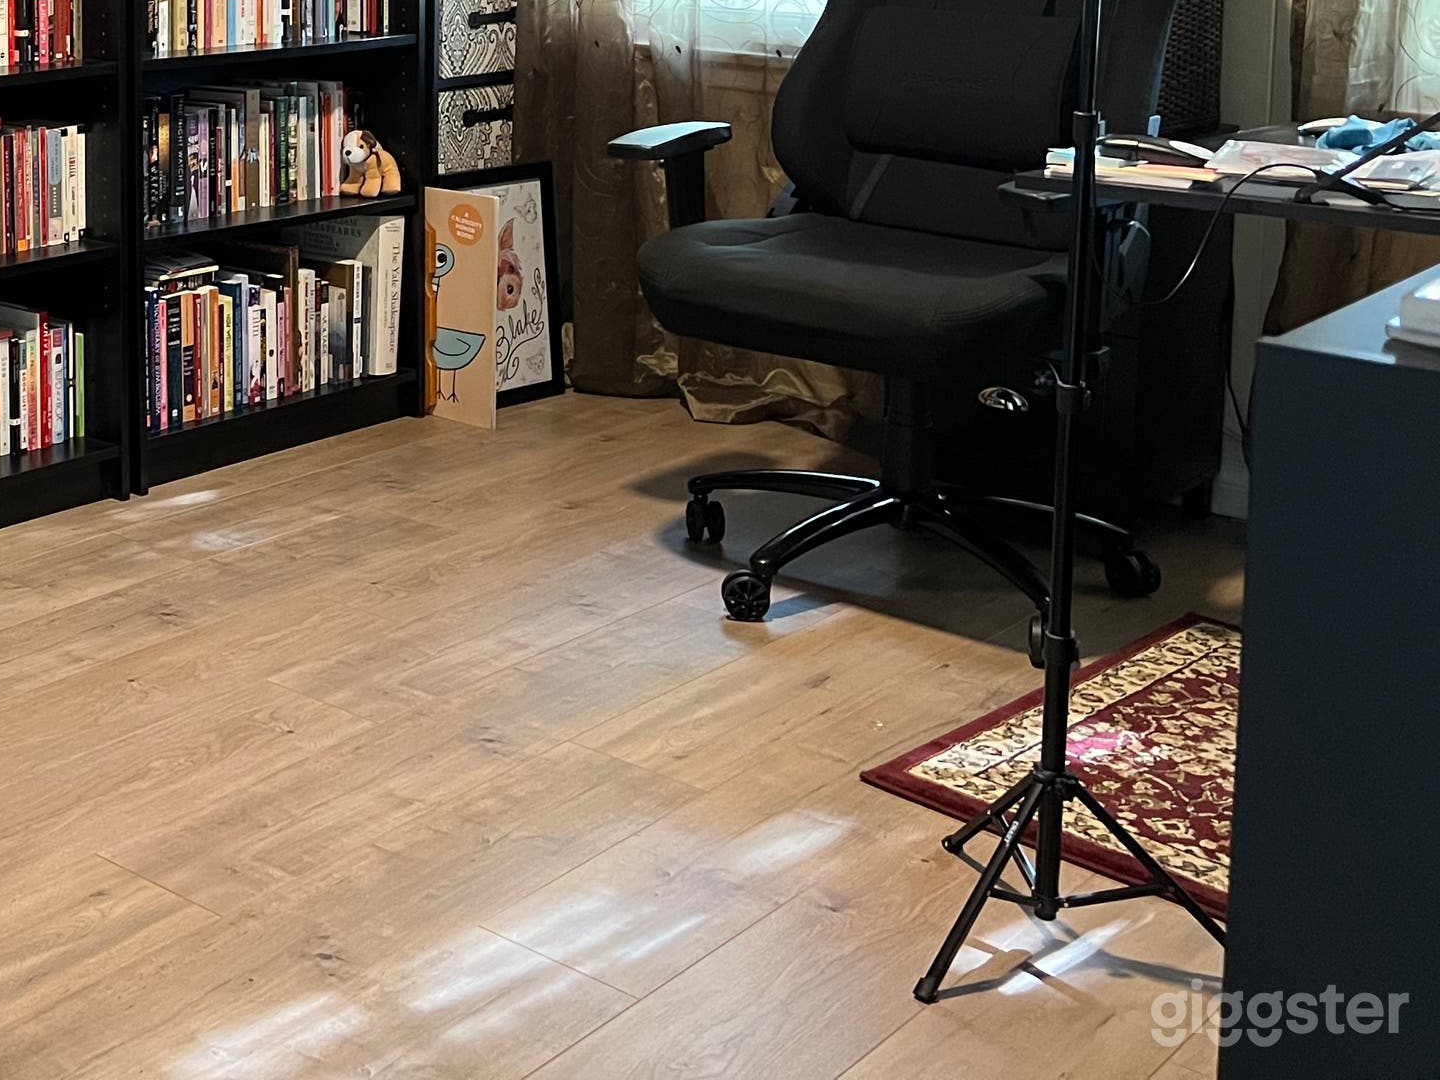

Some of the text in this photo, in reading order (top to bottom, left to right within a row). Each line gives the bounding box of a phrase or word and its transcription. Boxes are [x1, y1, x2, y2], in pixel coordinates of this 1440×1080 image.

[176, 118, 184, 147] NIGHT
[177, 150, 185, 182] WATCH
[387, 243, 400, 353] The Yale Shakespeare
[496, 296, 541, 366] Blake
